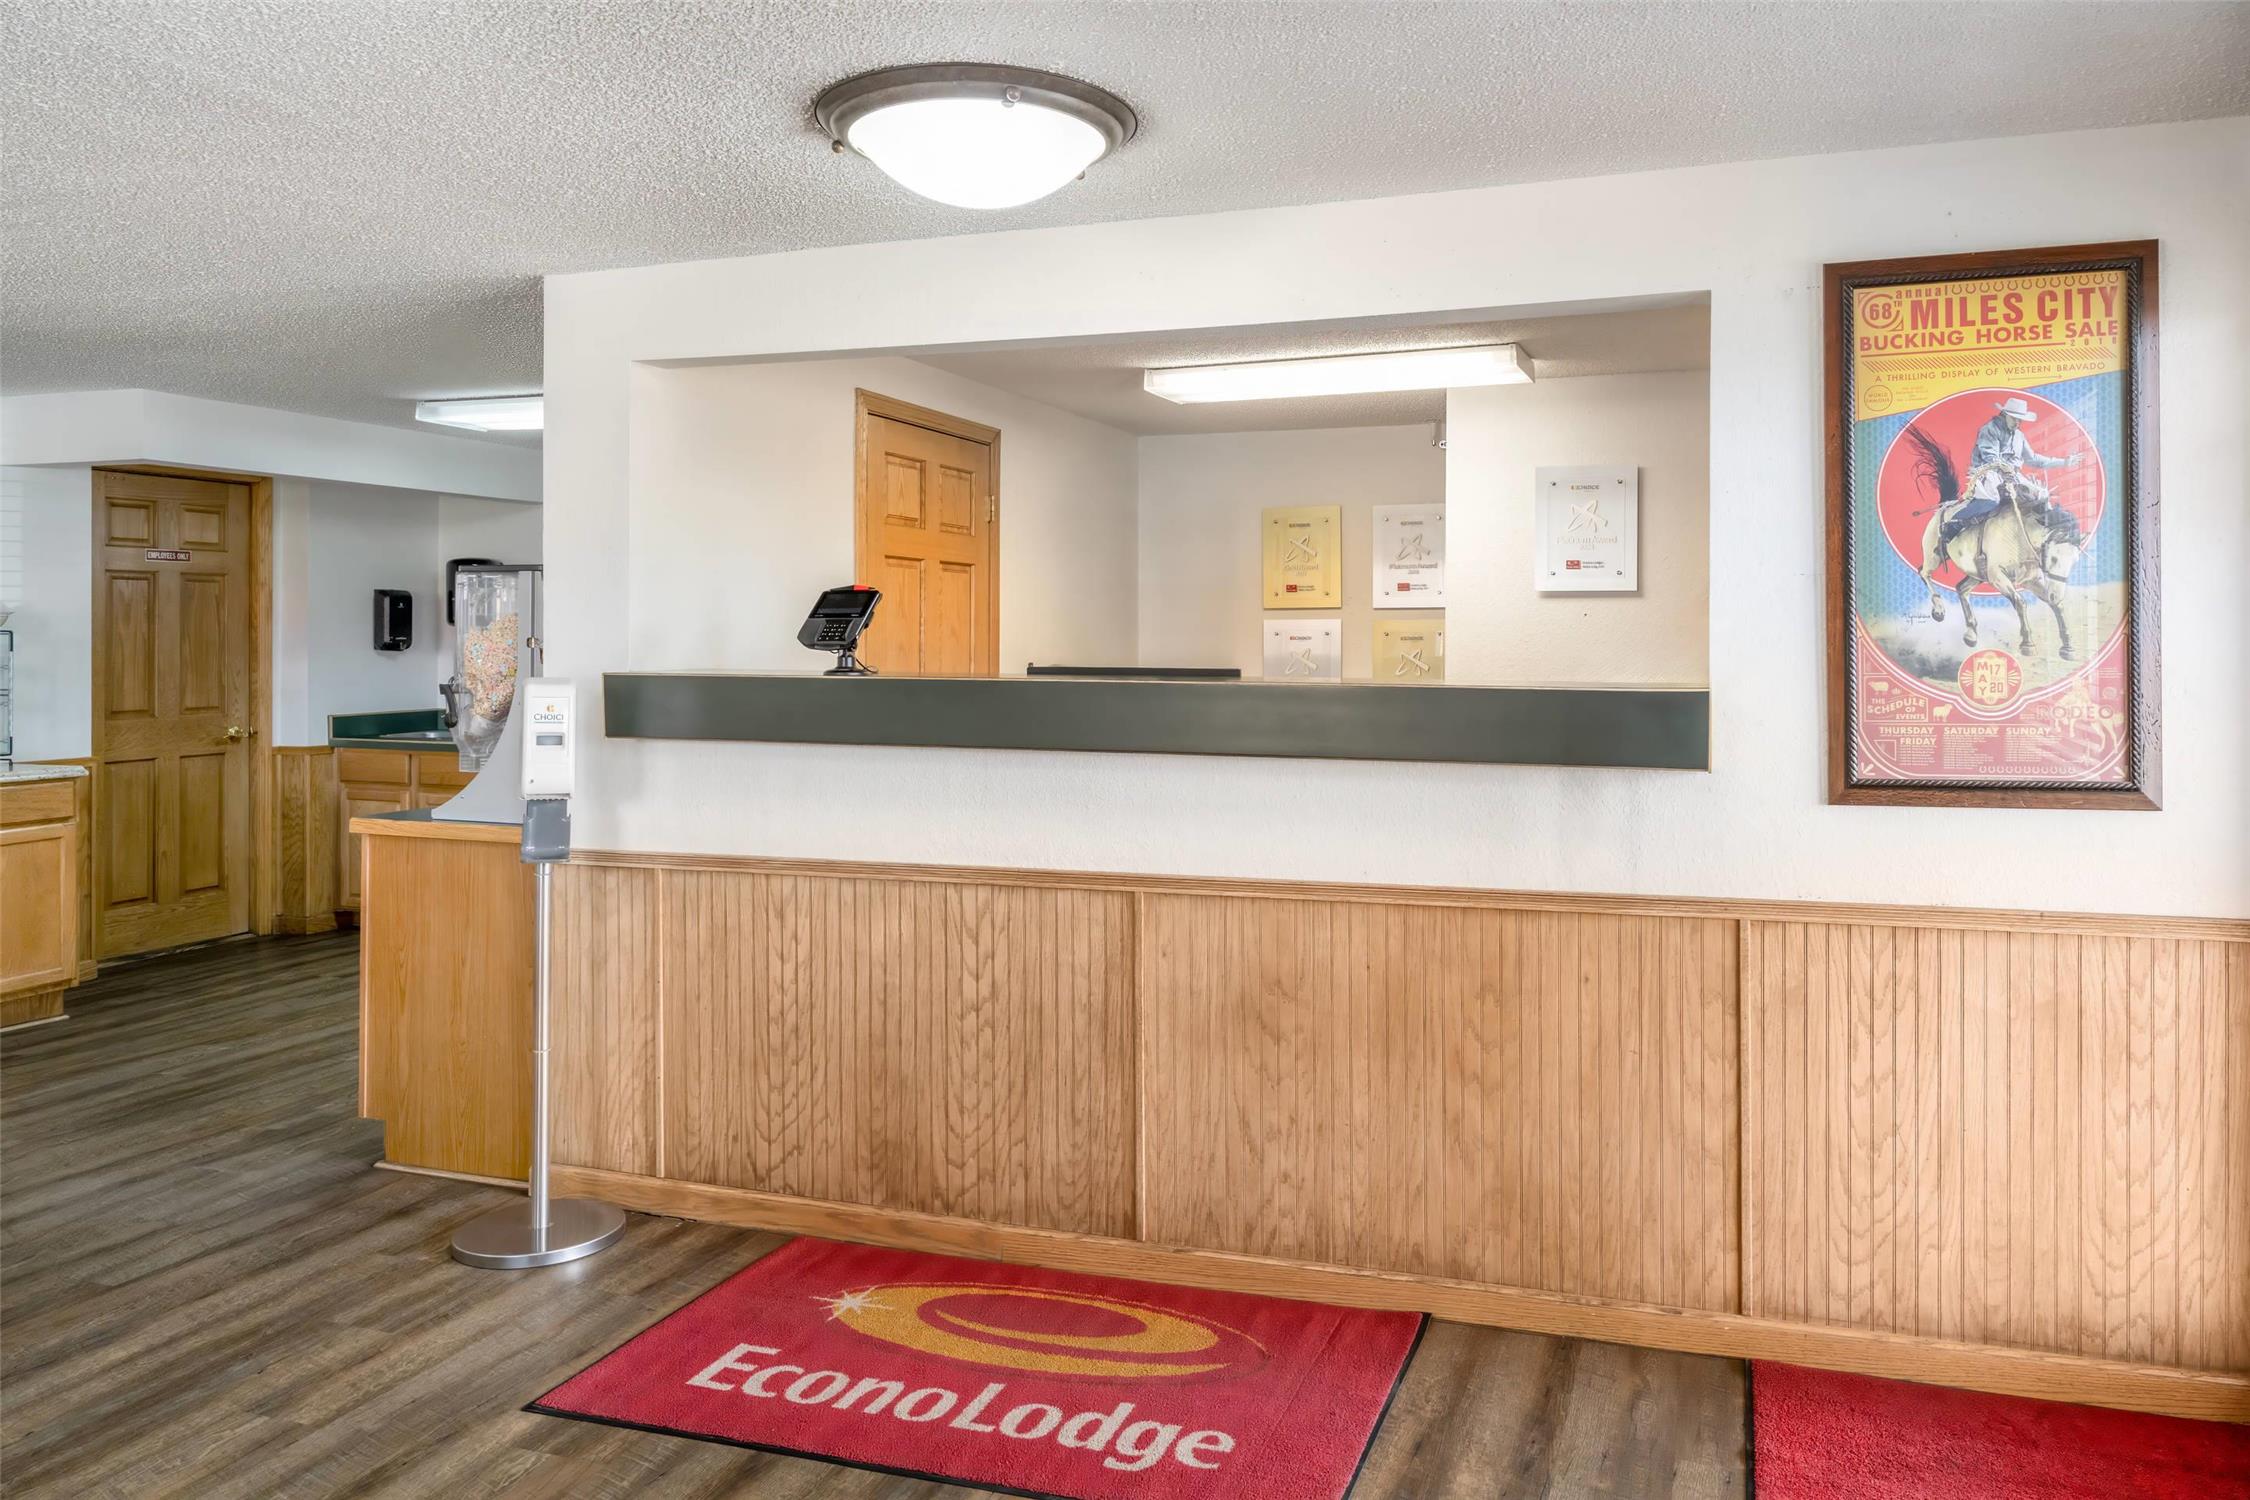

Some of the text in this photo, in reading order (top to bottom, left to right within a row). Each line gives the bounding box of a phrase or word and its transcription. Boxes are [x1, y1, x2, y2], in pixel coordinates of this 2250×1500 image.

[1895, 284, 1948, 299] annual
[1911, 286, 2118, 330] MILES CITY
[1860, 320, 2119, 351] BUCKING HORSE SALE
[1874, 361, 2105, 383] A THRILLING DISPLAY OF WESTERN BRAVADO
[147, 551, 190, 560] EMPLOYEES ONLY
[1989, 664, 2001, 676] 17
[1976, 661, 1989, 696] MAY
[1989, 682, 2004, 694] 20
[1867, 697, 1926, 715] SCHEDULE
[2038, 705, 2113, 719] RODEO
[1895, 713, 1926, 721] EVENTS
[1879, 726, 1935, 735] THURSDAY
[1943, 726, 2000, 735] SATURDAY
[2005, 726, 2051, 735] SUNDAY
[1900, 737, 1937, 746] FRIDAY
[686, 1343, 1235, 1471] EconoLodge
